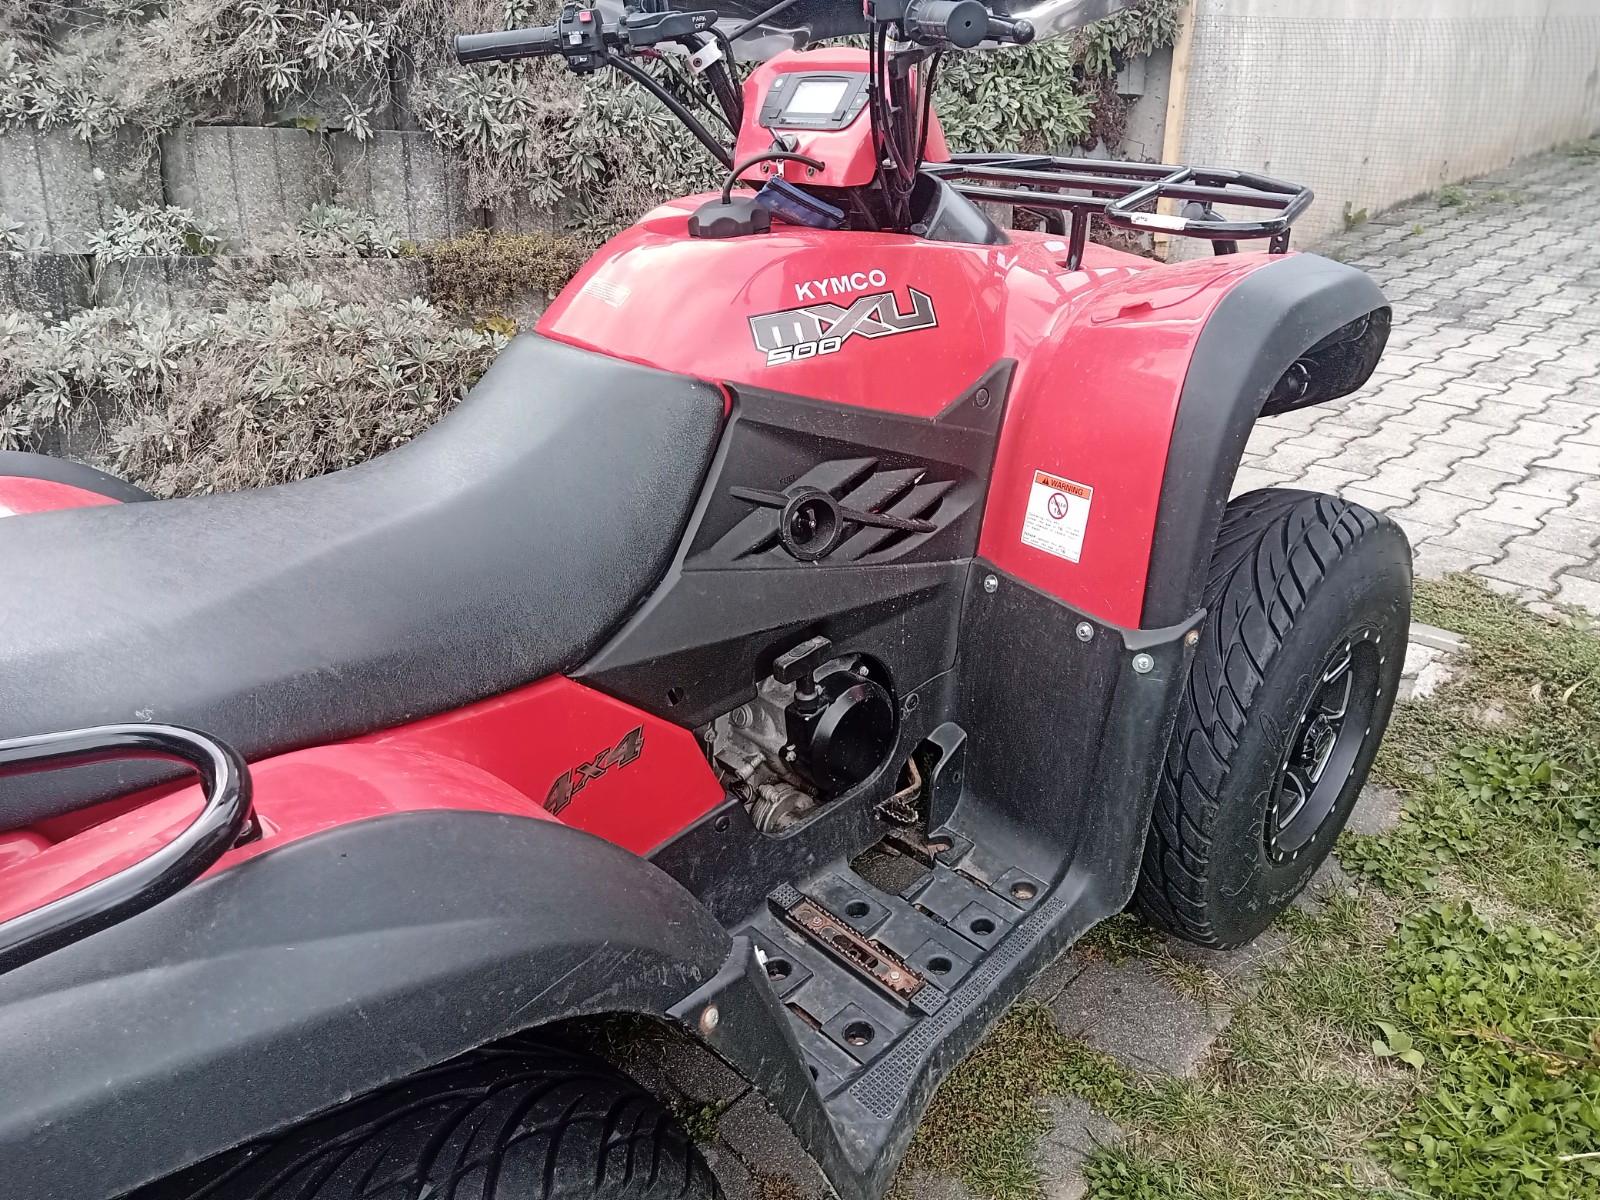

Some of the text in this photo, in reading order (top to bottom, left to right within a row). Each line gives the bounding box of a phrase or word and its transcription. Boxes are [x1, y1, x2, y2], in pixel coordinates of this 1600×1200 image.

[692, 15, 707, 23] PARK
[794, 269, 887, 302] KYMCO
[766, 336, 843, 367] 500
[1051, 479, 1084, 496] WARNING
